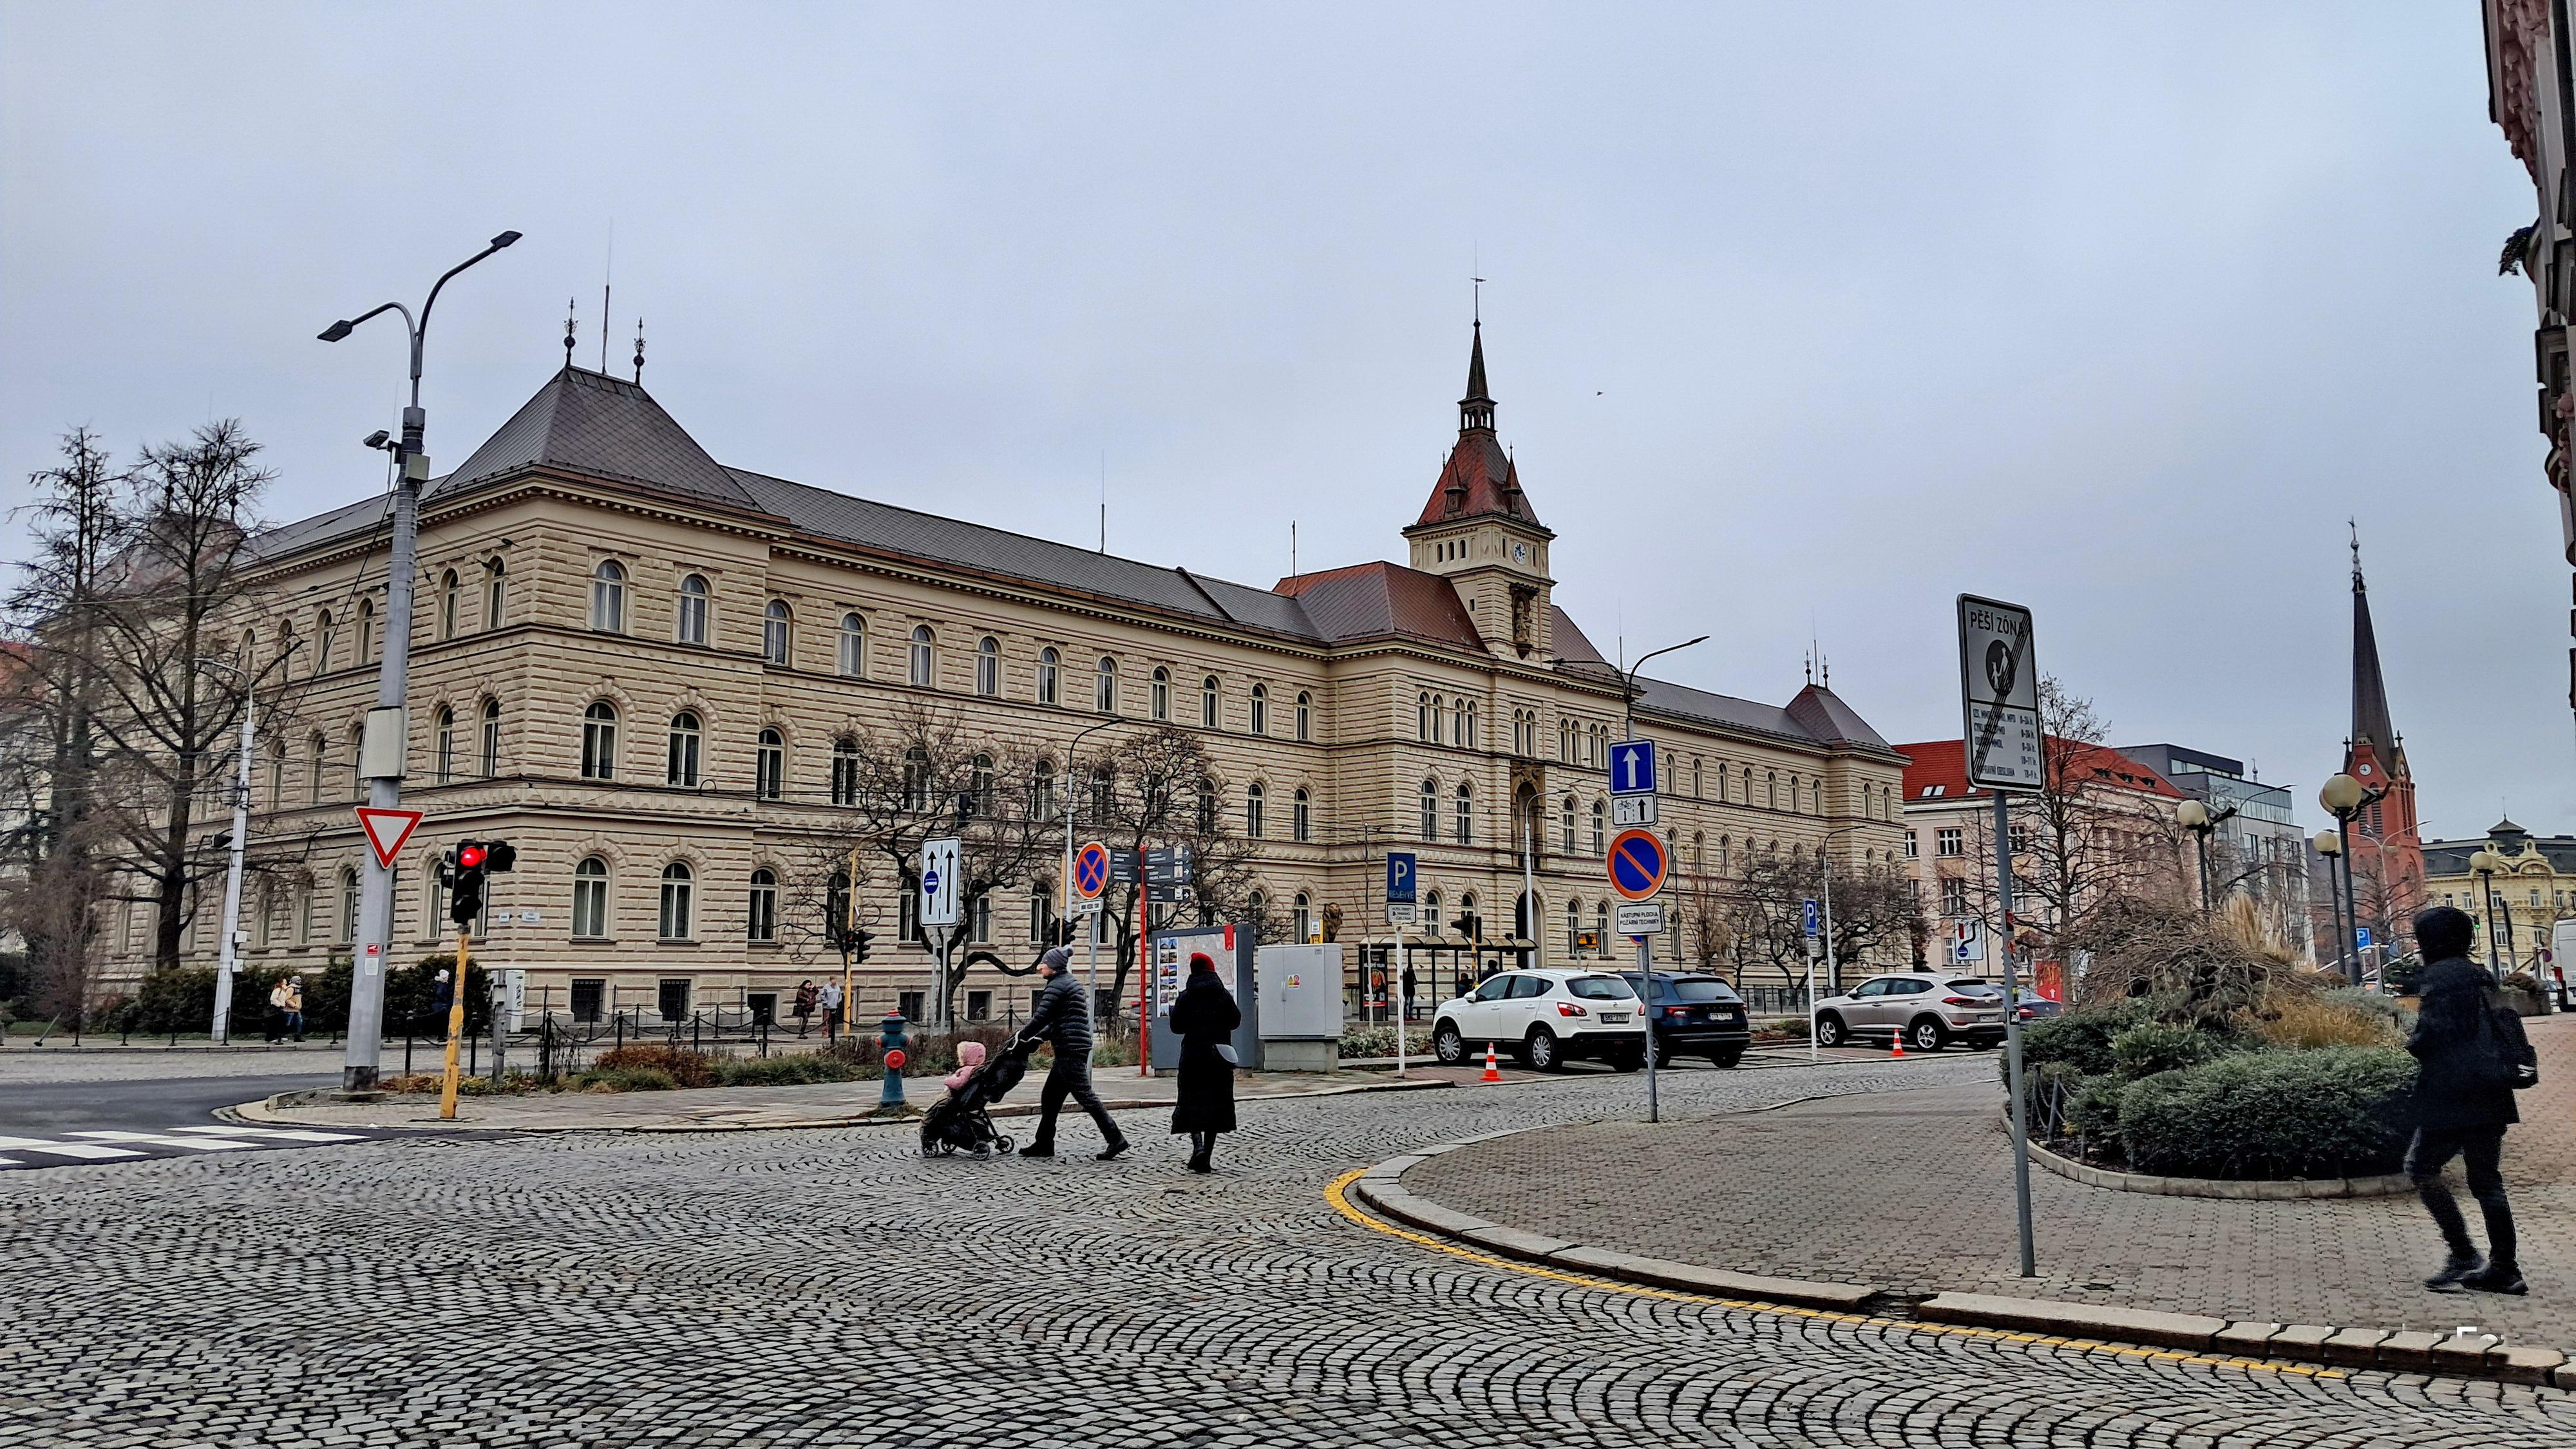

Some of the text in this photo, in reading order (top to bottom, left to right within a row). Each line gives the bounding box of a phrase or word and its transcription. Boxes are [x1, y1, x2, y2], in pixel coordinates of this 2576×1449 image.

[1971, 609, 1994, 632] PĚŠÍ
[1395, 860, 1408, 886] P
[1807, 904, 1814, 925] P
